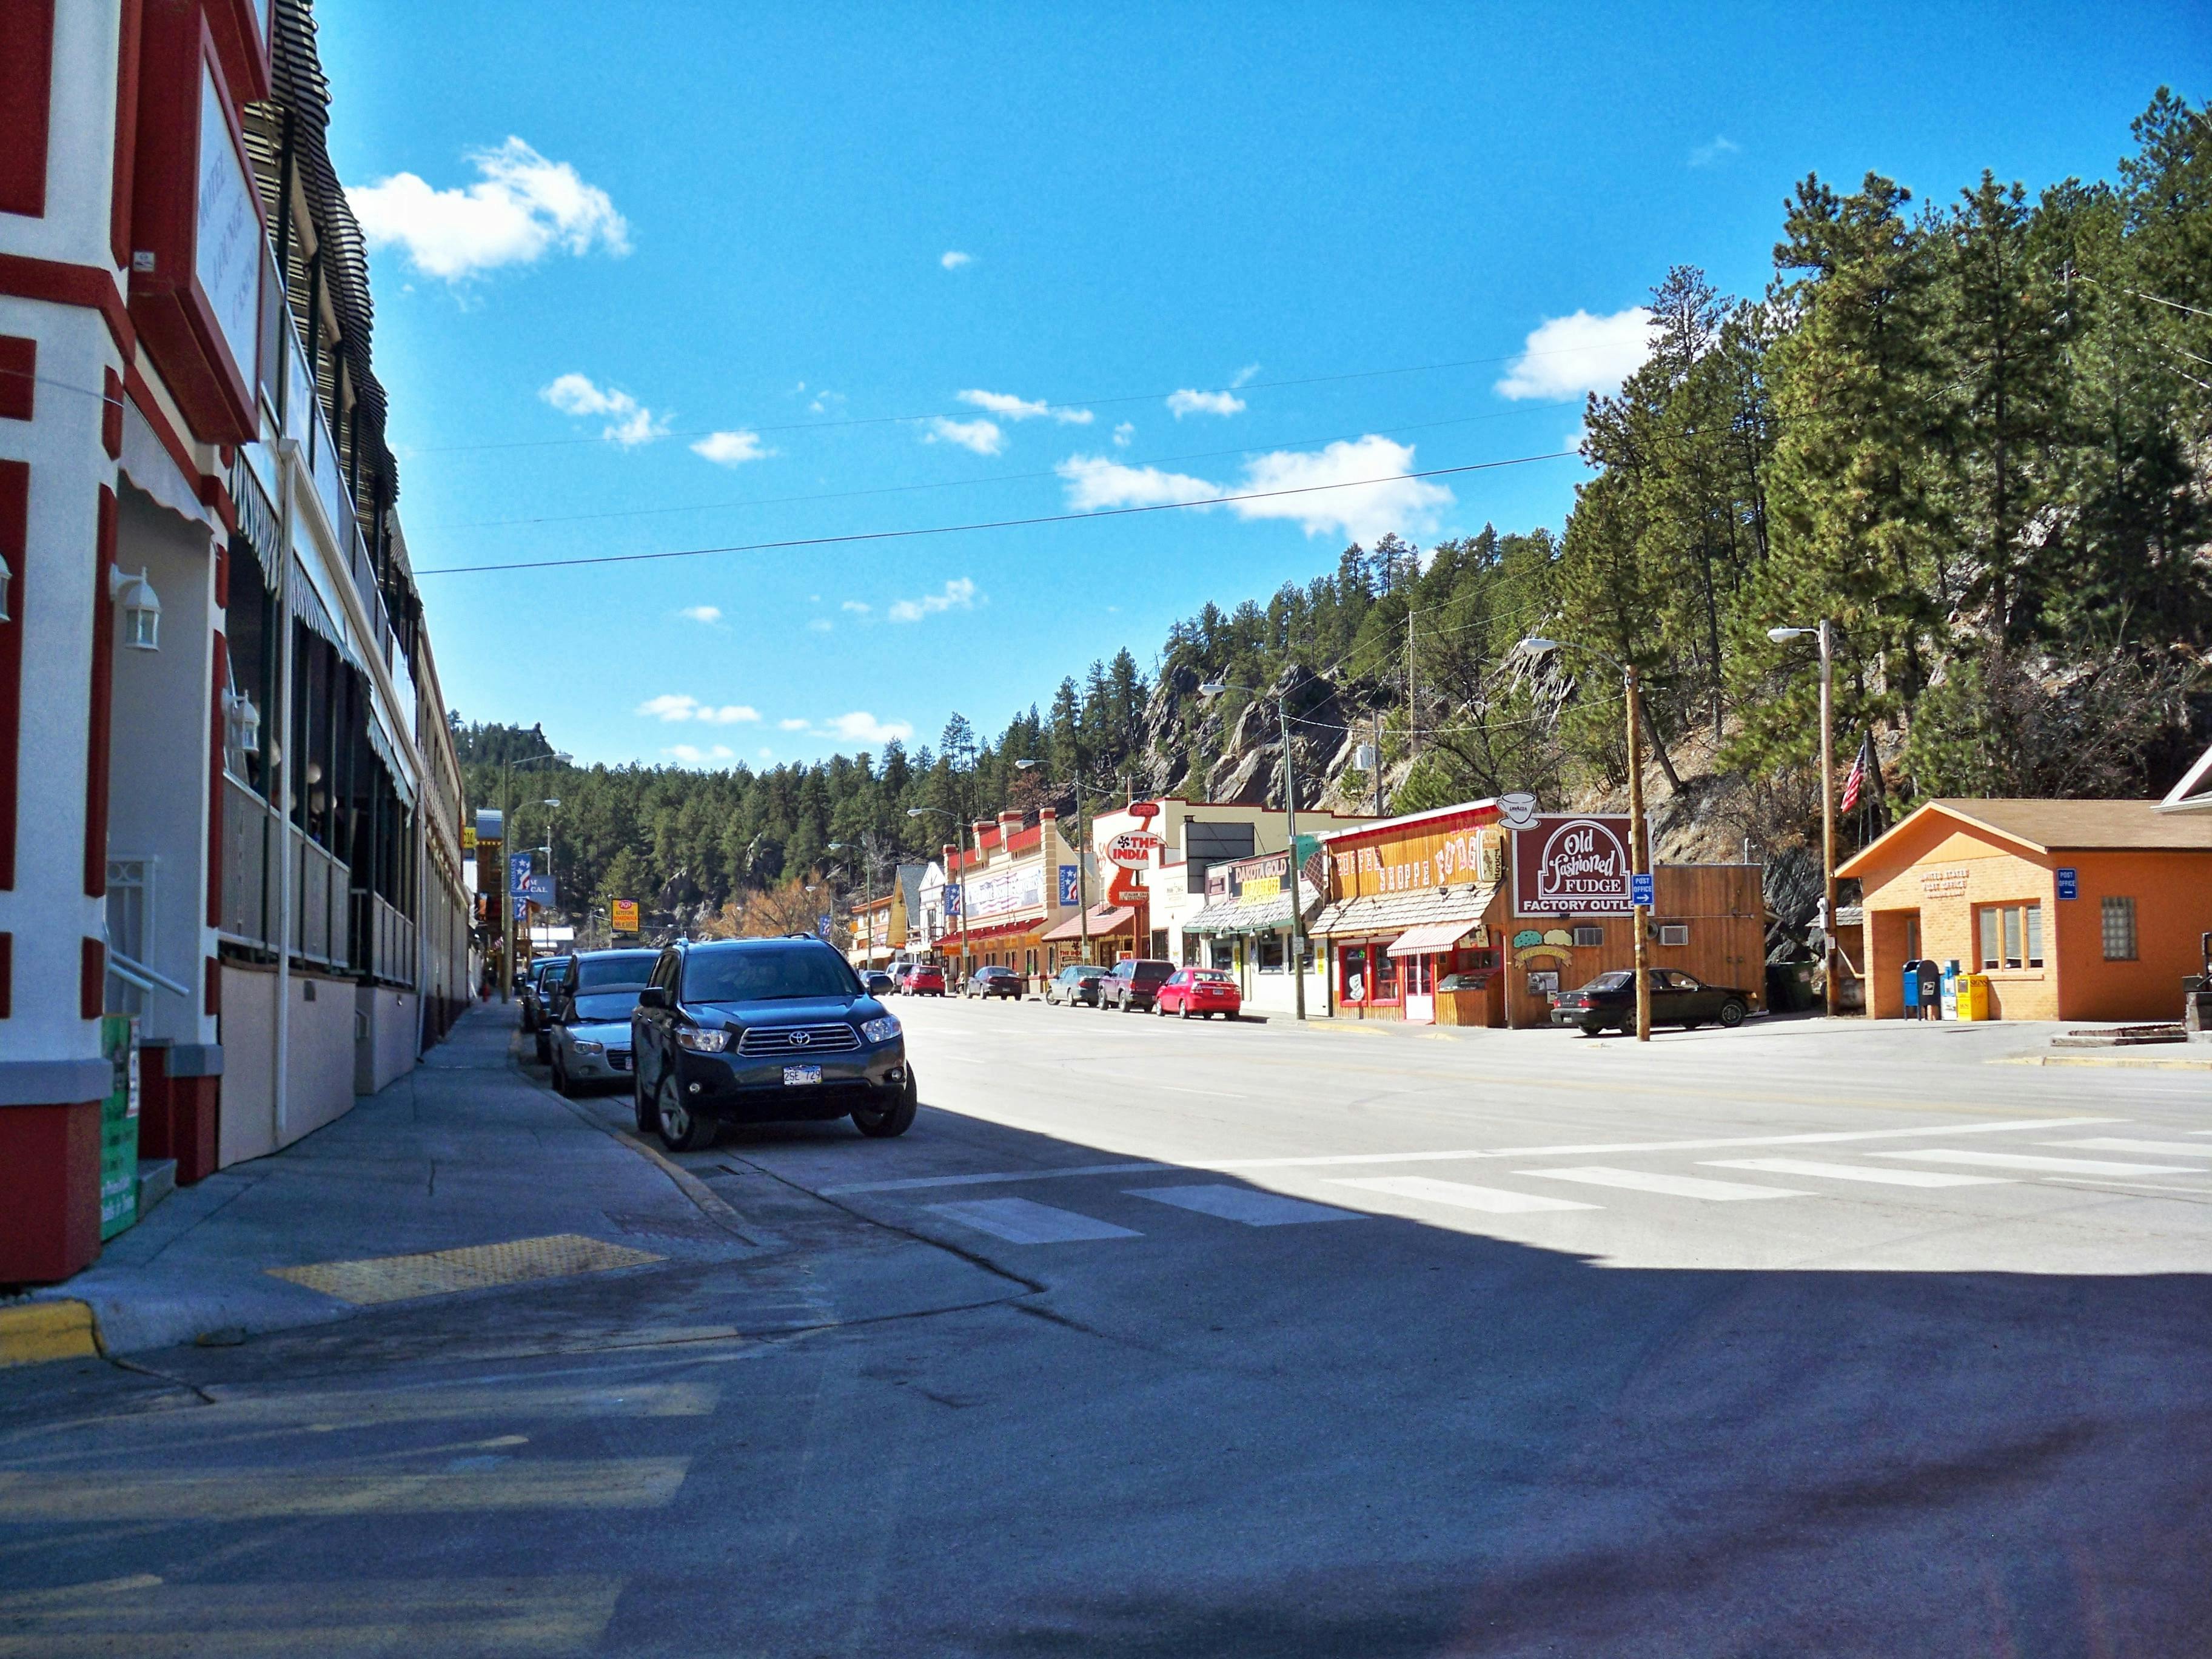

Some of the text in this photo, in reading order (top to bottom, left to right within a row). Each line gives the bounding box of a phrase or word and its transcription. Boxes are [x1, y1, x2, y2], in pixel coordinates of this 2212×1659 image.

[1130, 837, 1158, 848] THE
[1564, 829, 1594, 855] Old
[1113, 849, 1149, 860] INDIA
[1336, 846, 1381, 876] COFFEE
[1435, 836, 1476, 883] FUDG
[1235, 859, 1287, 883] DAKOTA GOLD
[1379, 860, 1430, 891] SHOPPE
[1268, 879, 1279, 895] OFF
[1565, 879, 1621, 892] FUDGE
[1523, 900, 1634, 911] FACTORY OUTLE
[785, 1070, 820, 1081] 2SE 729
